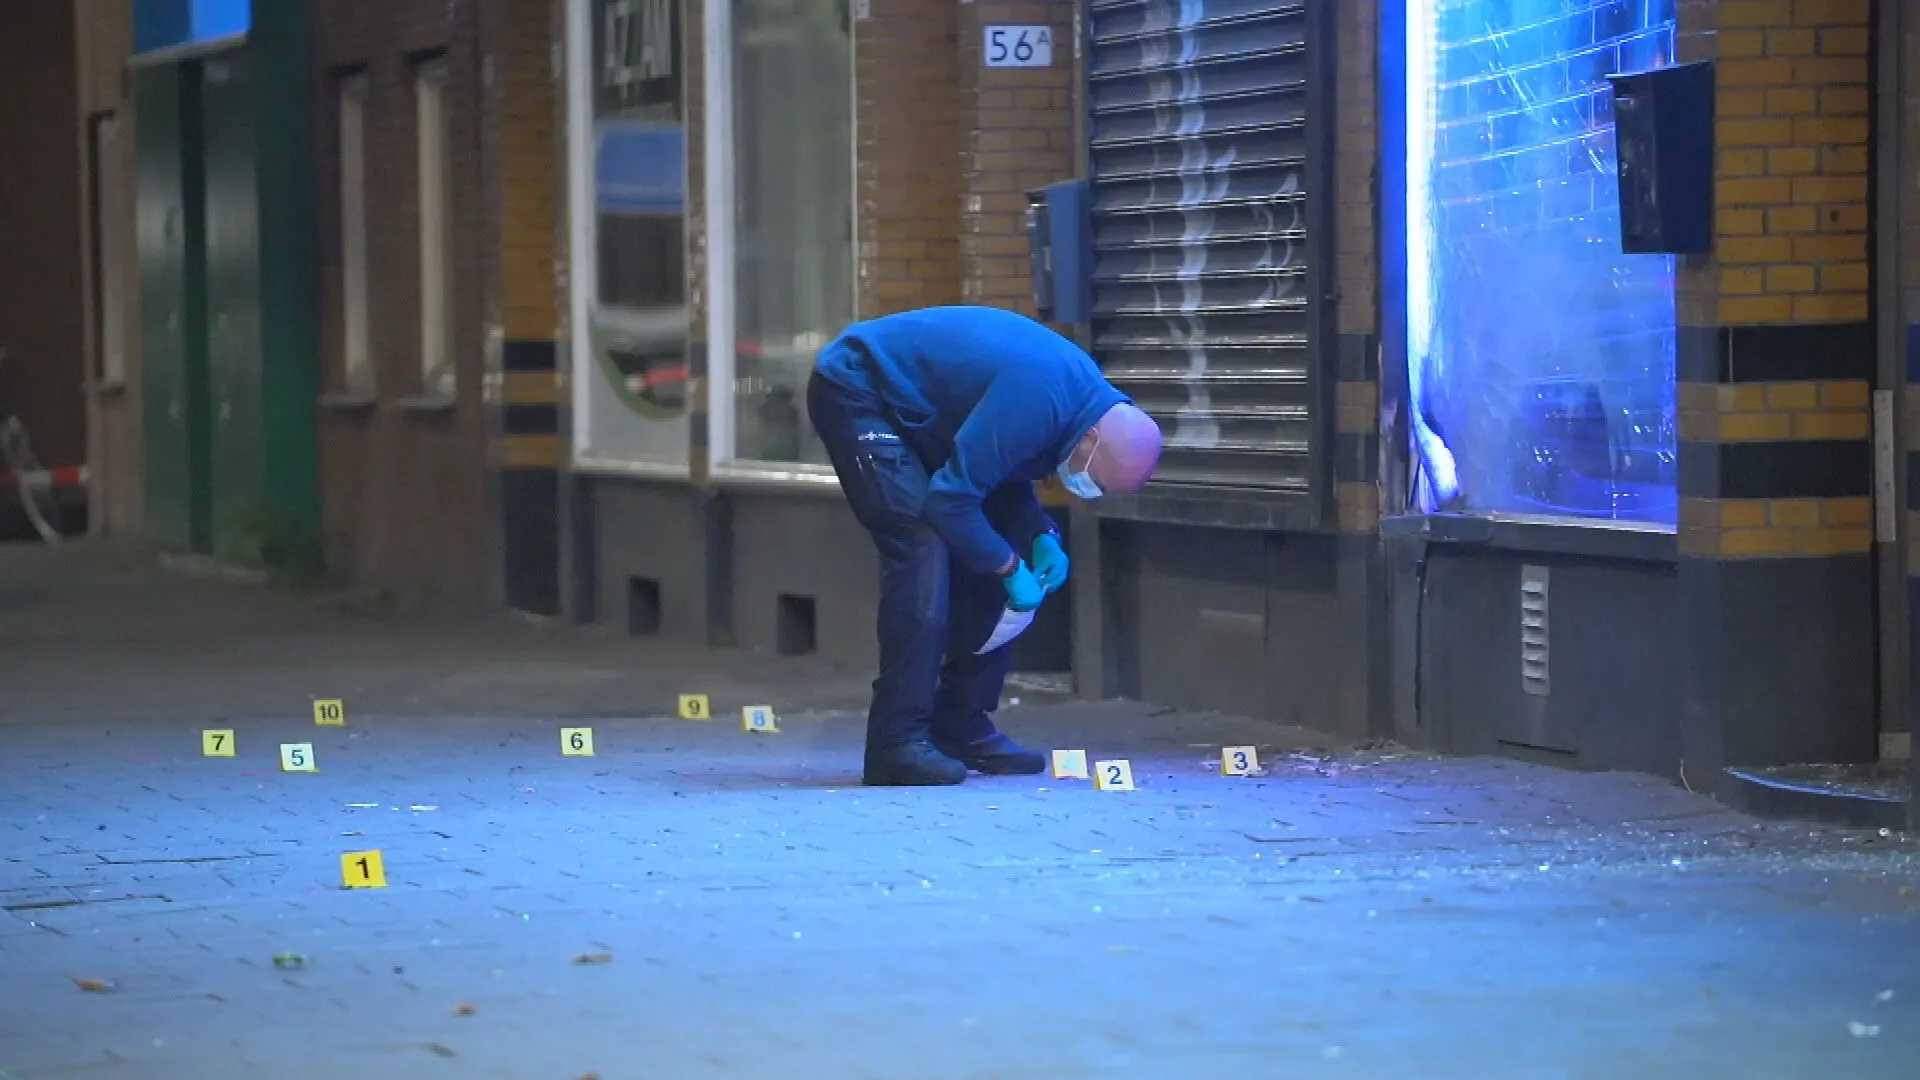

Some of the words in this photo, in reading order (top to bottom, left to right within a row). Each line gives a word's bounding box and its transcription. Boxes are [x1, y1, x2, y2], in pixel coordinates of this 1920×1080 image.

[318, 703, 340, 721] 10
[687, 698, 701, 715] 9
[752, 709, 767, 727] 8
[211, 734, 226, 751] 7
[570, 732, 584, 750] 6
[291, 749, 305, 767] 5
[1233, 751, 1249, 771] 3
[1107, 765, 1123, 785] 2
[355, 857, 369, 879] 1
